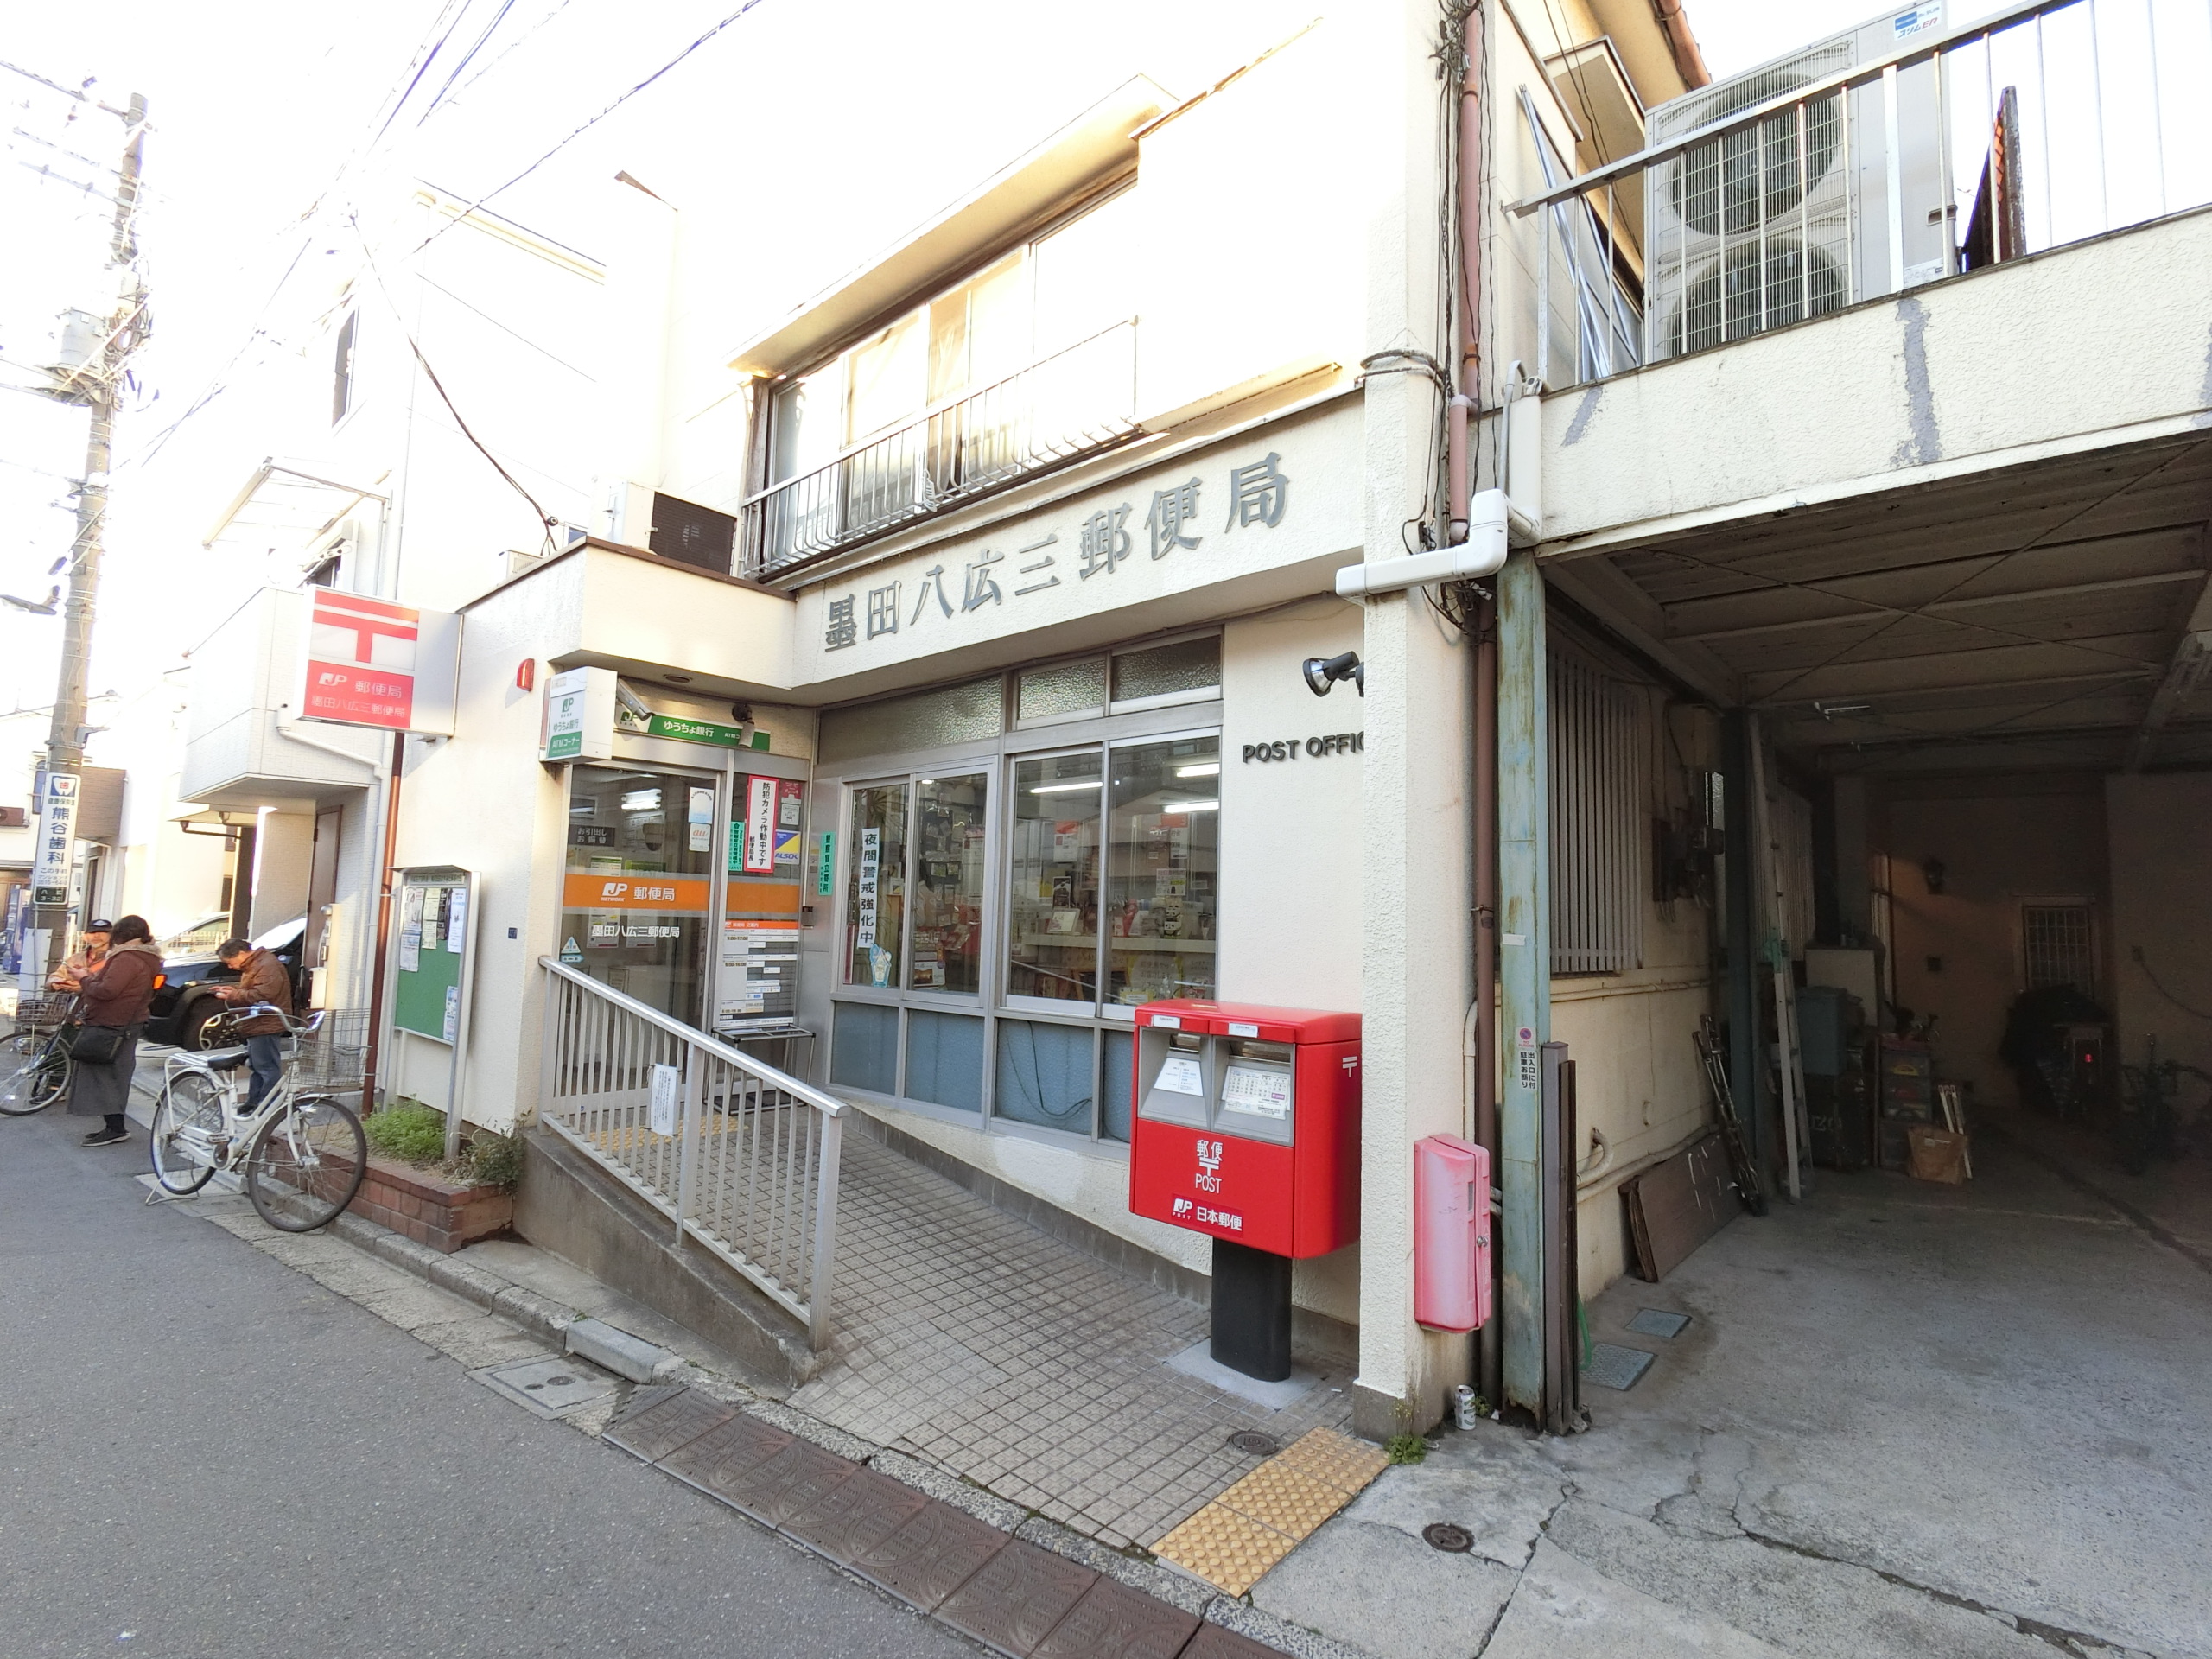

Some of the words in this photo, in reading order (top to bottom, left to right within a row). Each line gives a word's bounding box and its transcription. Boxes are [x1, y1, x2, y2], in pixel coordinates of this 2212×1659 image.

[824, 452, 1290, 653] 墨田八広三郵便局
[354, 680, 402, 699] 郵便局
[553, 718, 579, 733] ゆうちょ銀行
[664, 721, 715, 738] ゆうちょ銀行
[551, 736, 580, 748] ATMコーナー
[1243, 739, 1300, 764] POST
[1306, 731, 1364, 758] OFFIC
[577, 827, 607, 836] お引出し
[758, 782, 772, 867] 防犯カメラ作動中です
[47, 806, 70, 865] 熊谷歯科
[633, 887, 676, 902] 郵便局
[860, 833, 878, 944] 夜間警戒強化中
[591, 925, 680, 938] 墨田八広三郵便局
[1197, 1139, 1223, 1162] 郵便
[1195, 1173, 1222, 1194] POST
[1197, 1205, 1243, 1231] 日本郵便
